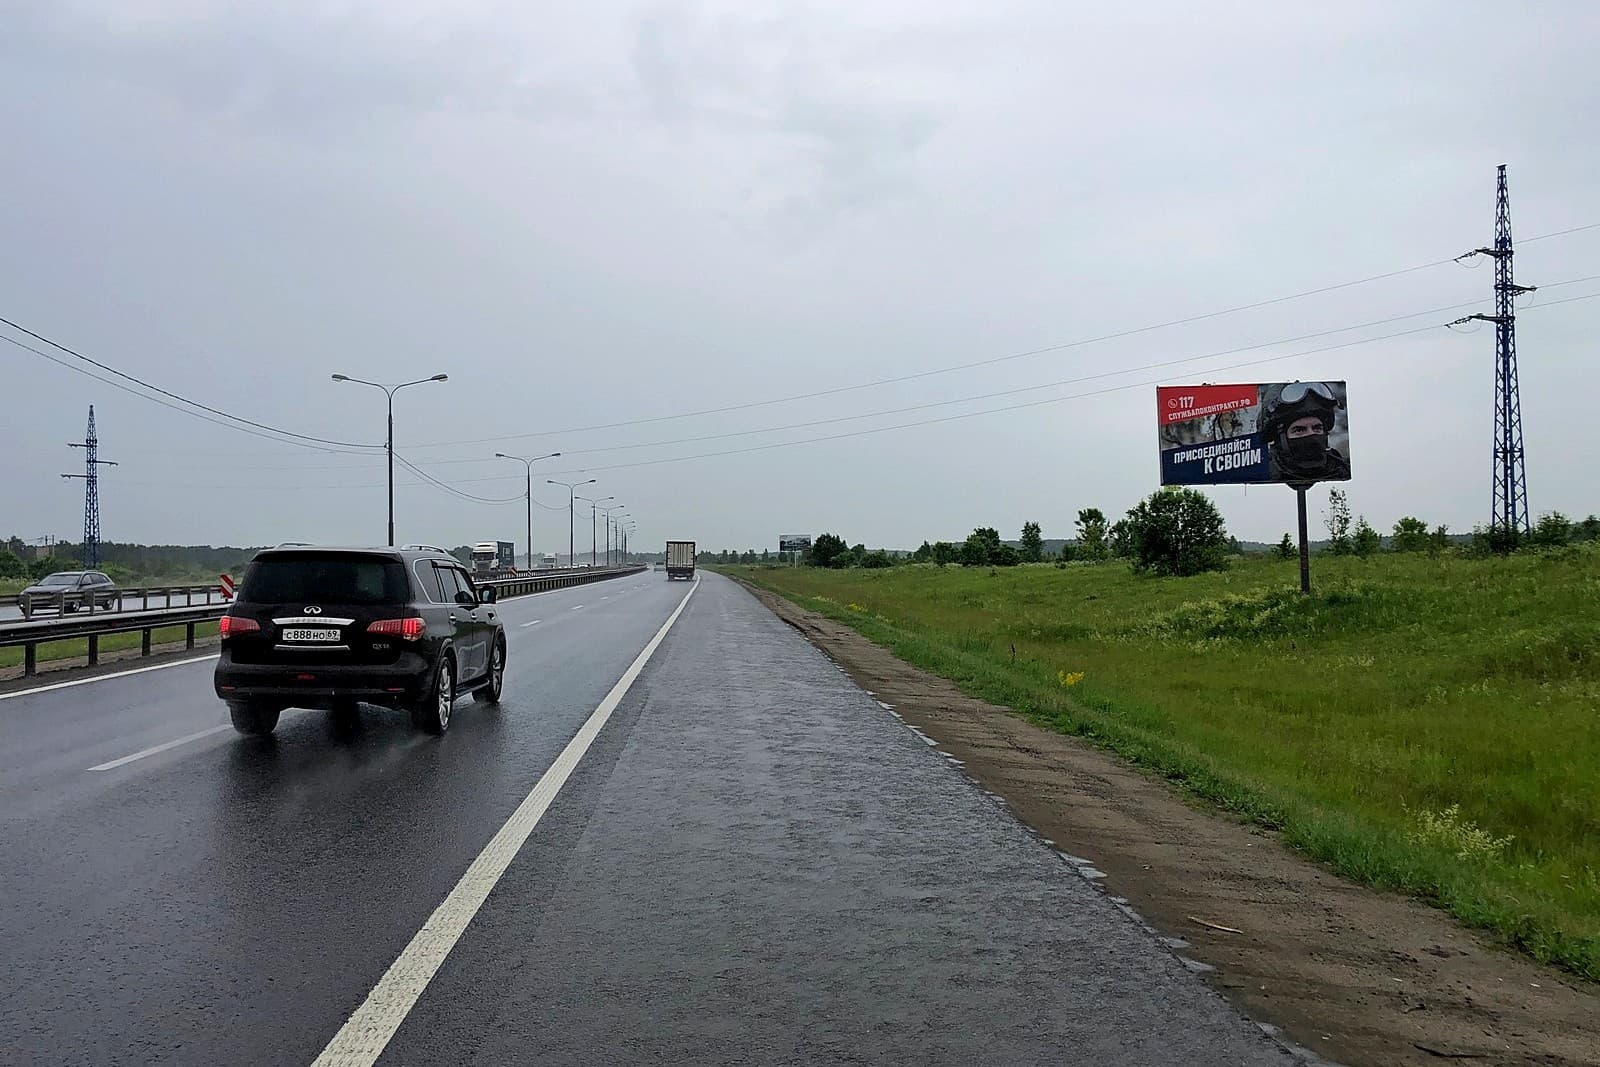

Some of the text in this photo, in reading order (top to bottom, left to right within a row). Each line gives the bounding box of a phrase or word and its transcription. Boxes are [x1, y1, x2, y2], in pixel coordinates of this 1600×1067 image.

[1168, 398, 1251, 420] СЛУЖБАПОКОНТРАКТУ.РФ
[1178, 396, 1194, 409] 117
[1174, 438, 1252, 464] ПРИСОЕДИНЯЙСЯ
[1204, 448, 1261, 474] К СВОИМ
